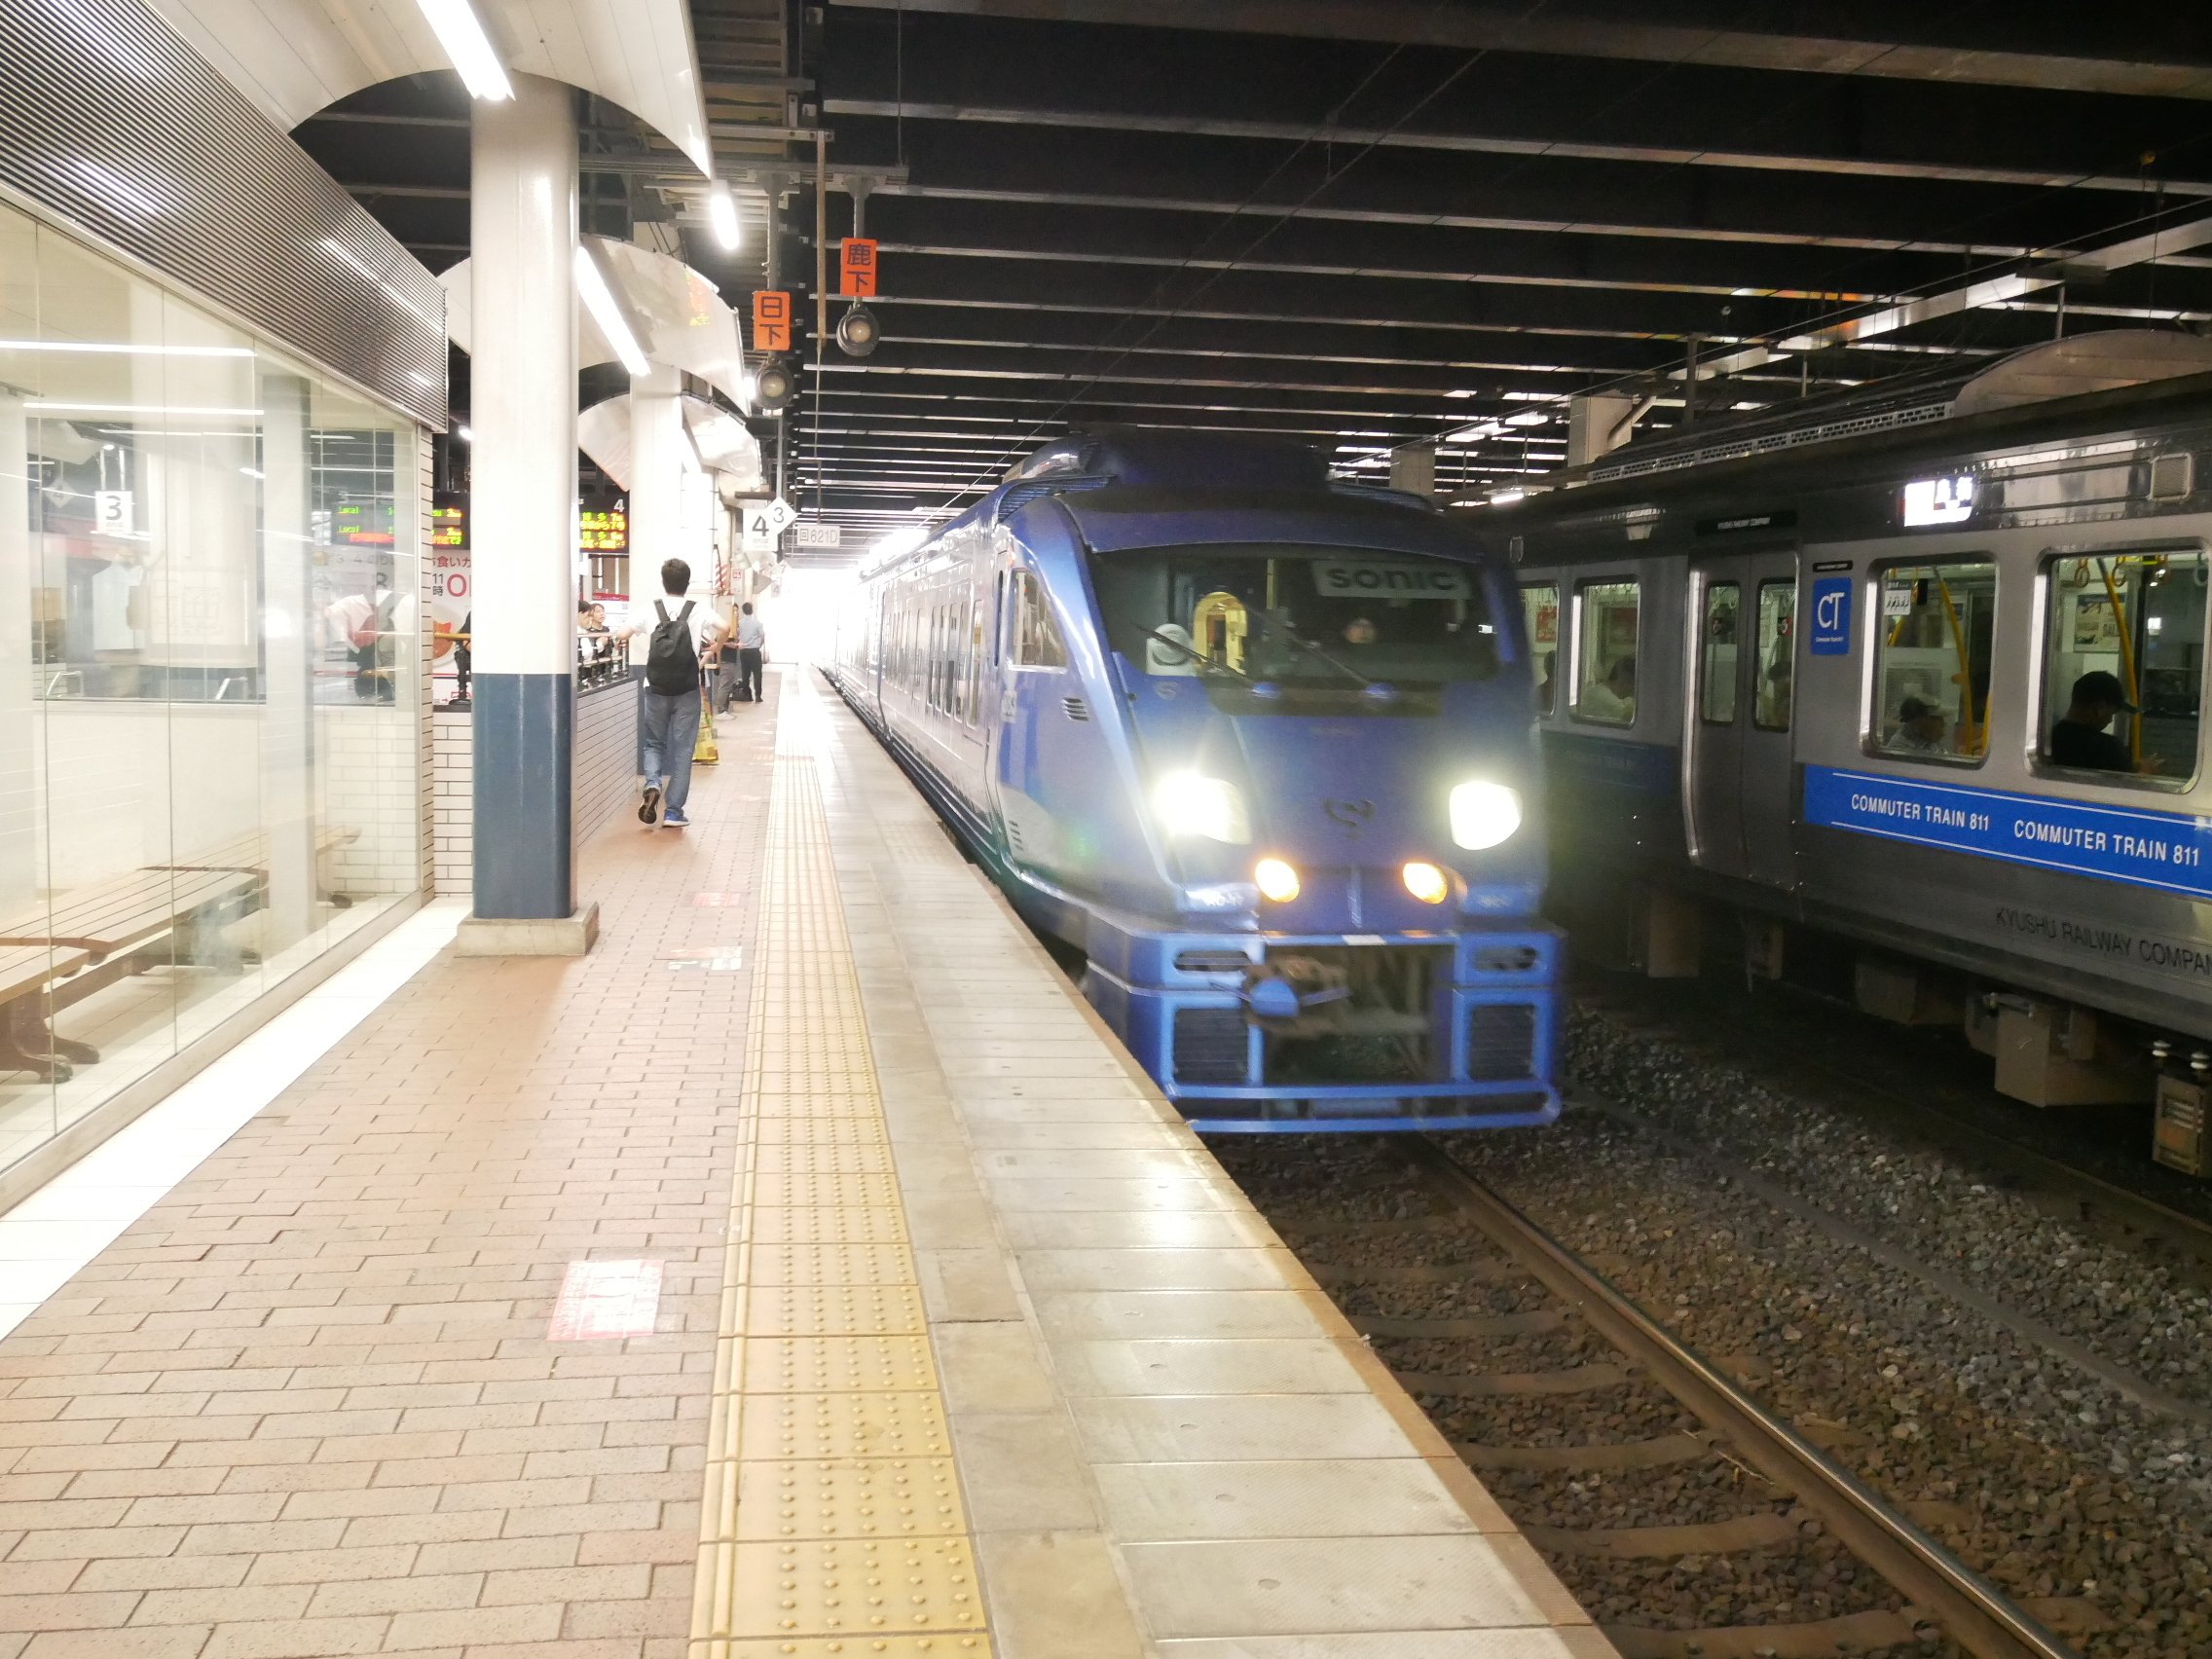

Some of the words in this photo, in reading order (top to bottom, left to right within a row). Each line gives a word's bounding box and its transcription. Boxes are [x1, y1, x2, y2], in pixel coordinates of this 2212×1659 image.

[847, 243, 872, 293] 鹿下
[759, 296, 784, 346] 日下
[105, 495, 123, 521] 3
[613, 498, 625, 512] 4
[773, 506, 785, 523] 3
[752, 515, 770, 537] 4
[432, 555, 471, 568] 食いカ
[1818, 592, 1845, 631] CT
[1851, 793, 1921, 820] COMMUTER
[1925, 805, 1966, 828] TRAIN
[1970, 813, 1990, 831] 811
[2014, 819, 2107, 852] COMMUTER
[2113, 834, 2167, 862] TRAIN
[2173, 844, 2199, 866] 811
[1996, 907, 2056, 939] KYUSHU
[2062, 922, 2131, 956] RAILWAY
